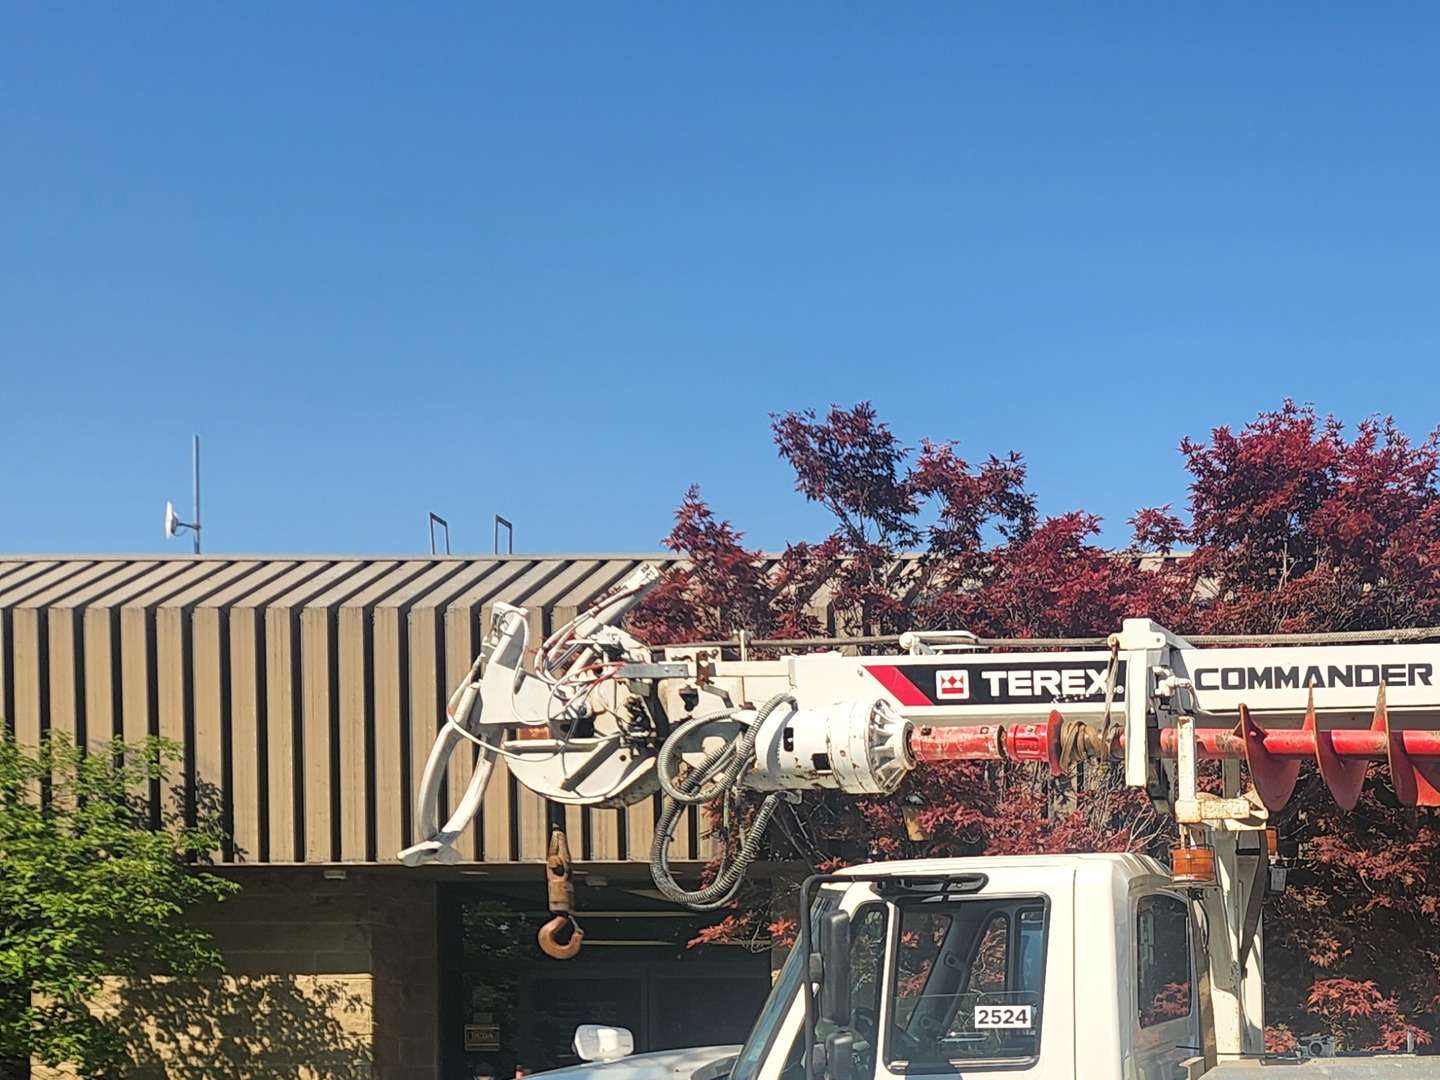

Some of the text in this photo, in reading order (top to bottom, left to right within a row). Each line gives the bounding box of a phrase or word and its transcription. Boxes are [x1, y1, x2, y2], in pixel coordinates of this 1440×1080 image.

[981, 668, 1115, 697] TEREX
[1194, 663, 1433, 690] COMMANDER
[978, 1009, 1028, 1024] 2524
